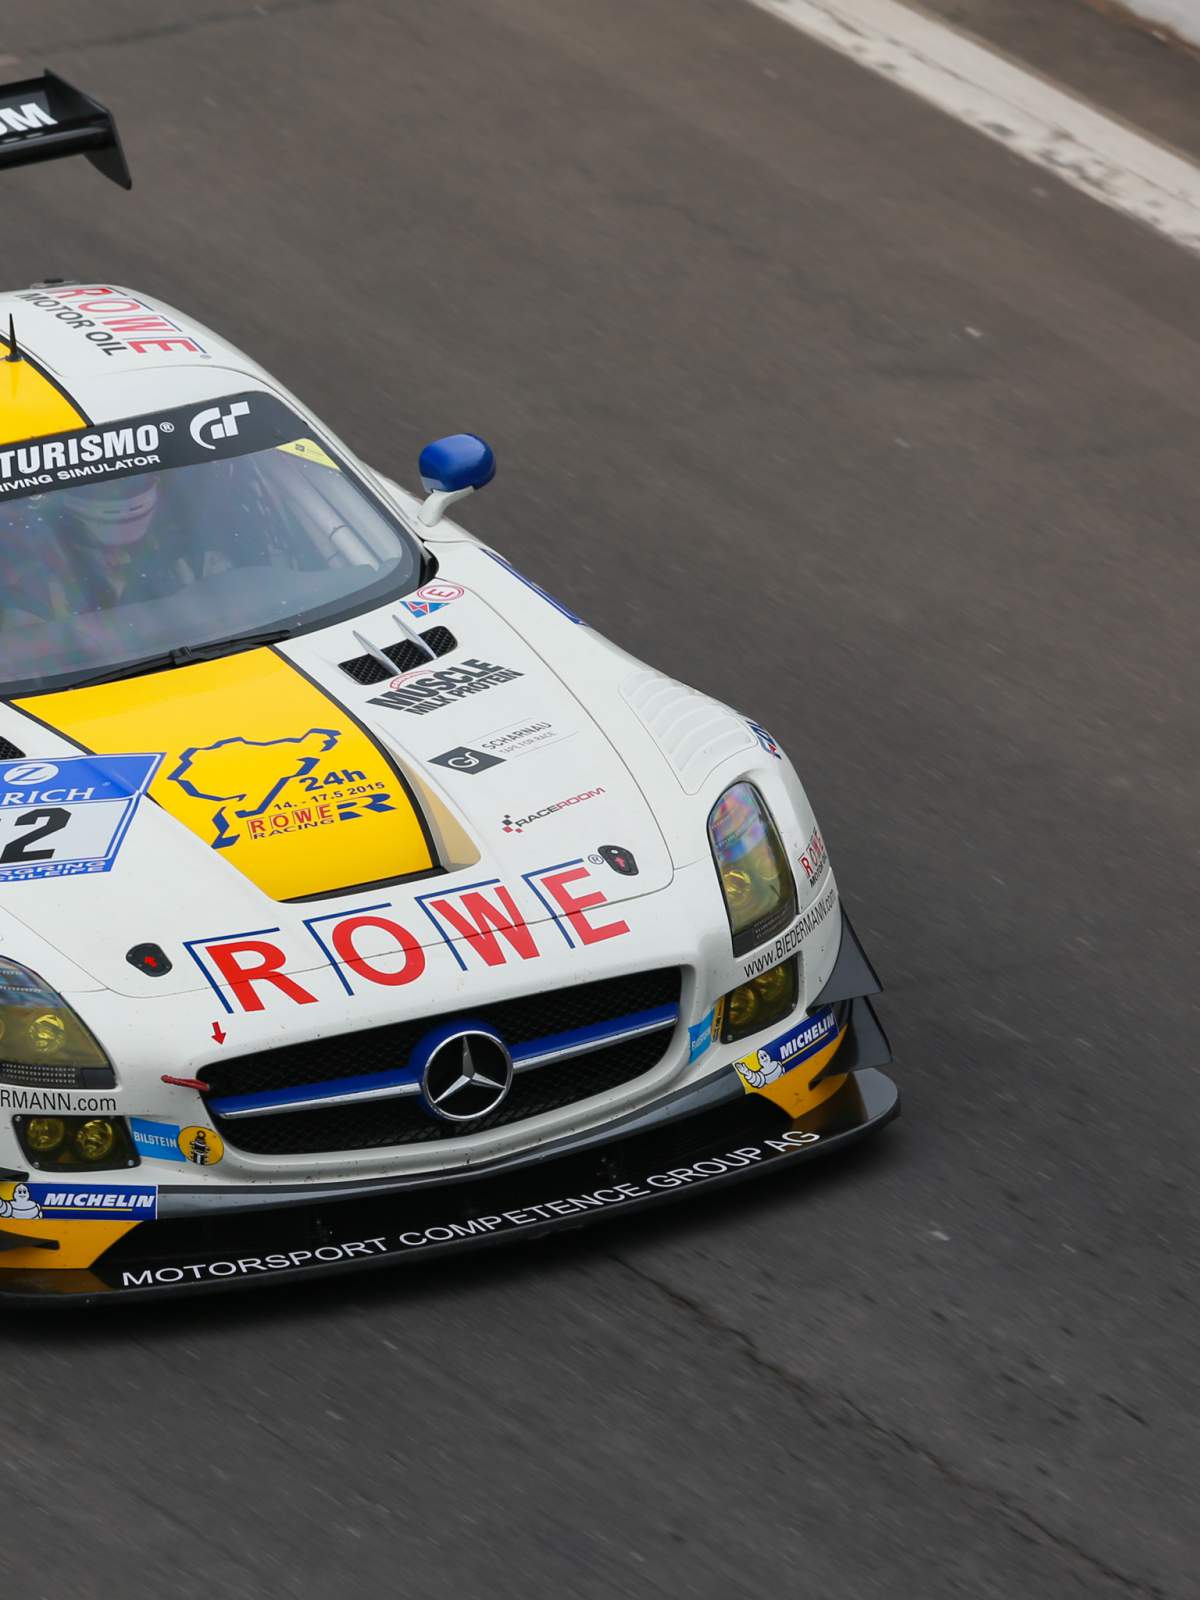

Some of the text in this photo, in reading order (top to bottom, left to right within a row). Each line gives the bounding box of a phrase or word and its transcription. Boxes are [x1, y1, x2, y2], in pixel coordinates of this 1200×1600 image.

[15, 292, 128, 356] MOTOR OIL
[48, 287, 201, 353] ROWE
[57, 454, 161, 481] SIMULATOR
[365, 658, 505, 711] MUSCLE
[404, 695, 458, 715] MILK
[446, 668, 526, 698] PROTEIN
[481, 721, 552, 750] SCHARNAU
[299, 768, 368, 792] 24h
[347, 782, 385, 796] 2015
[249, 803, 334, 834] ROWE
[515, 786, 606, 828] RACEROOM
[253, 818, 336, 840] RACING
[200, 864, 631, 1012] ROWE
[780, 1012, 836, 1060] MICHELIN
[133, 1131, 177, 1149] BILSTEIN
[45, 1192, 155, 1209] MICHELIN
[122, 1129, 821, 1288] MOTORSPORT COMPETENCE GROUP AG
